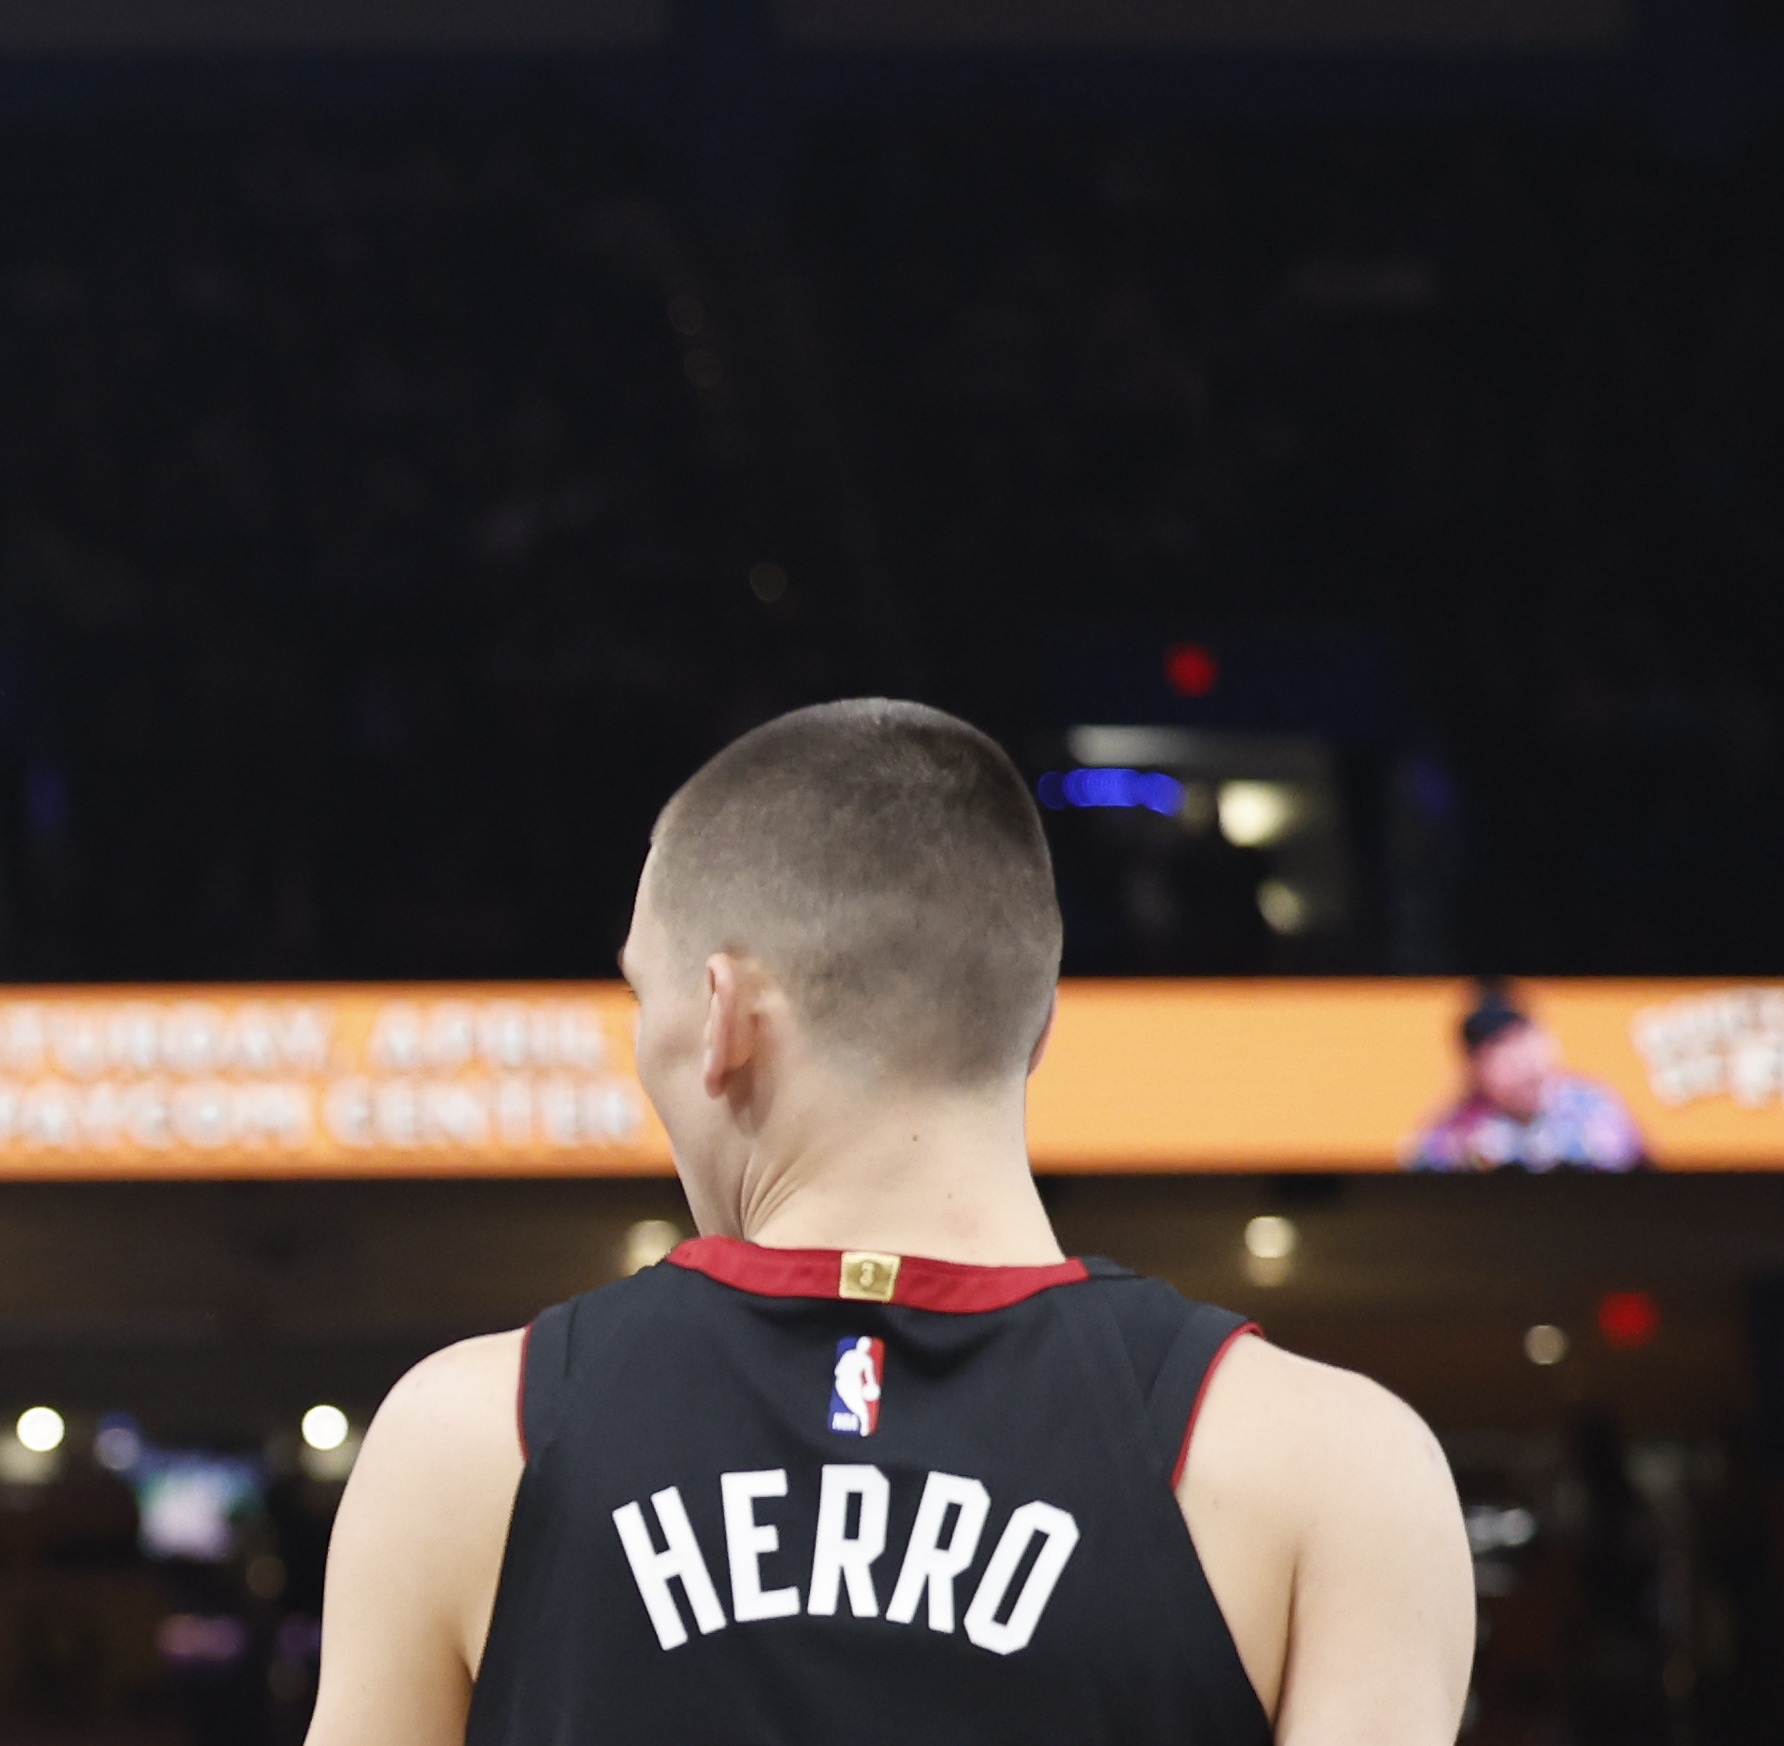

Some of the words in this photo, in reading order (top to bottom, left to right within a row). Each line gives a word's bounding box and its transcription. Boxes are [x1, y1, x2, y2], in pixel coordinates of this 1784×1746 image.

[370, 1004, 612, 1075] APRIL
[326, 1075, 646, 1147] CENTER
[612, 1464, 1080, 1655] HERRO
